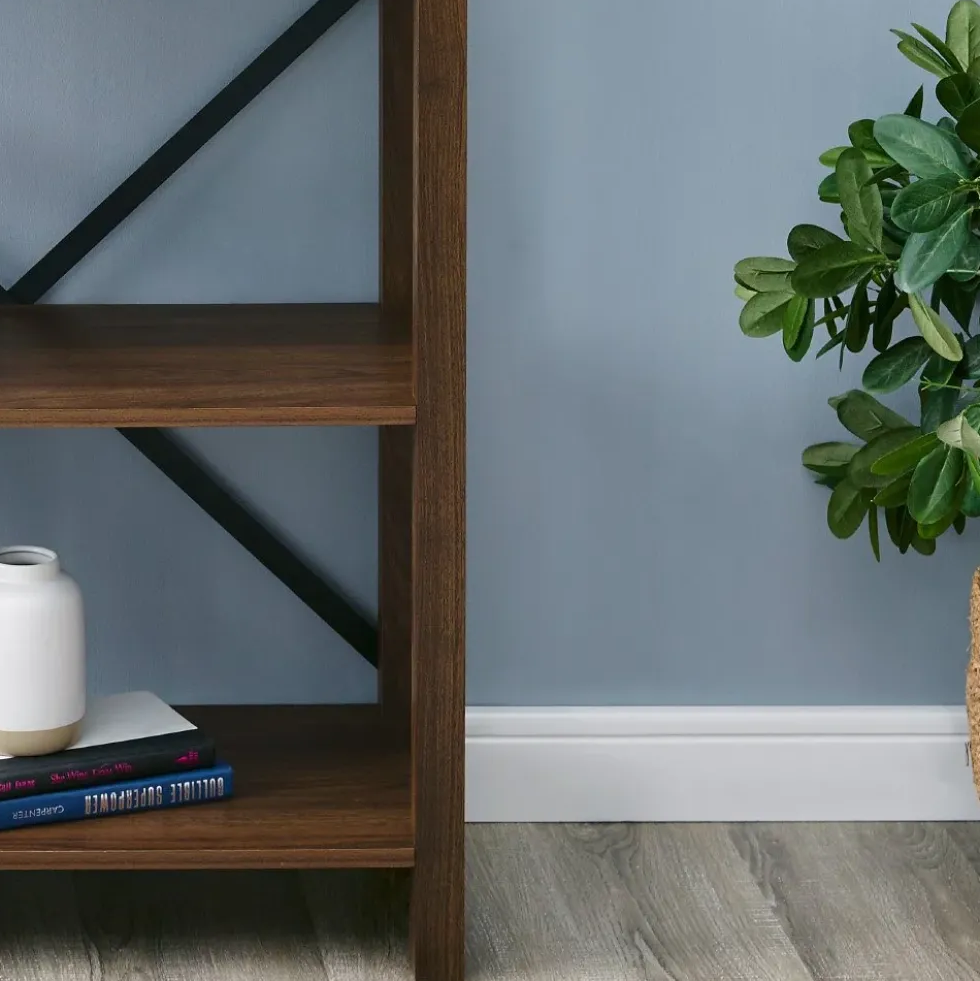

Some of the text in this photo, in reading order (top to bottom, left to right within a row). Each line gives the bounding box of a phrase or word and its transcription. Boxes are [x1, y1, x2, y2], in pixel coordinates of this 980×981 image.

[85, 777, 224, 815] GULLIBLE SUPERPOWER
[12, 804, 65, 820] CARPENTER
